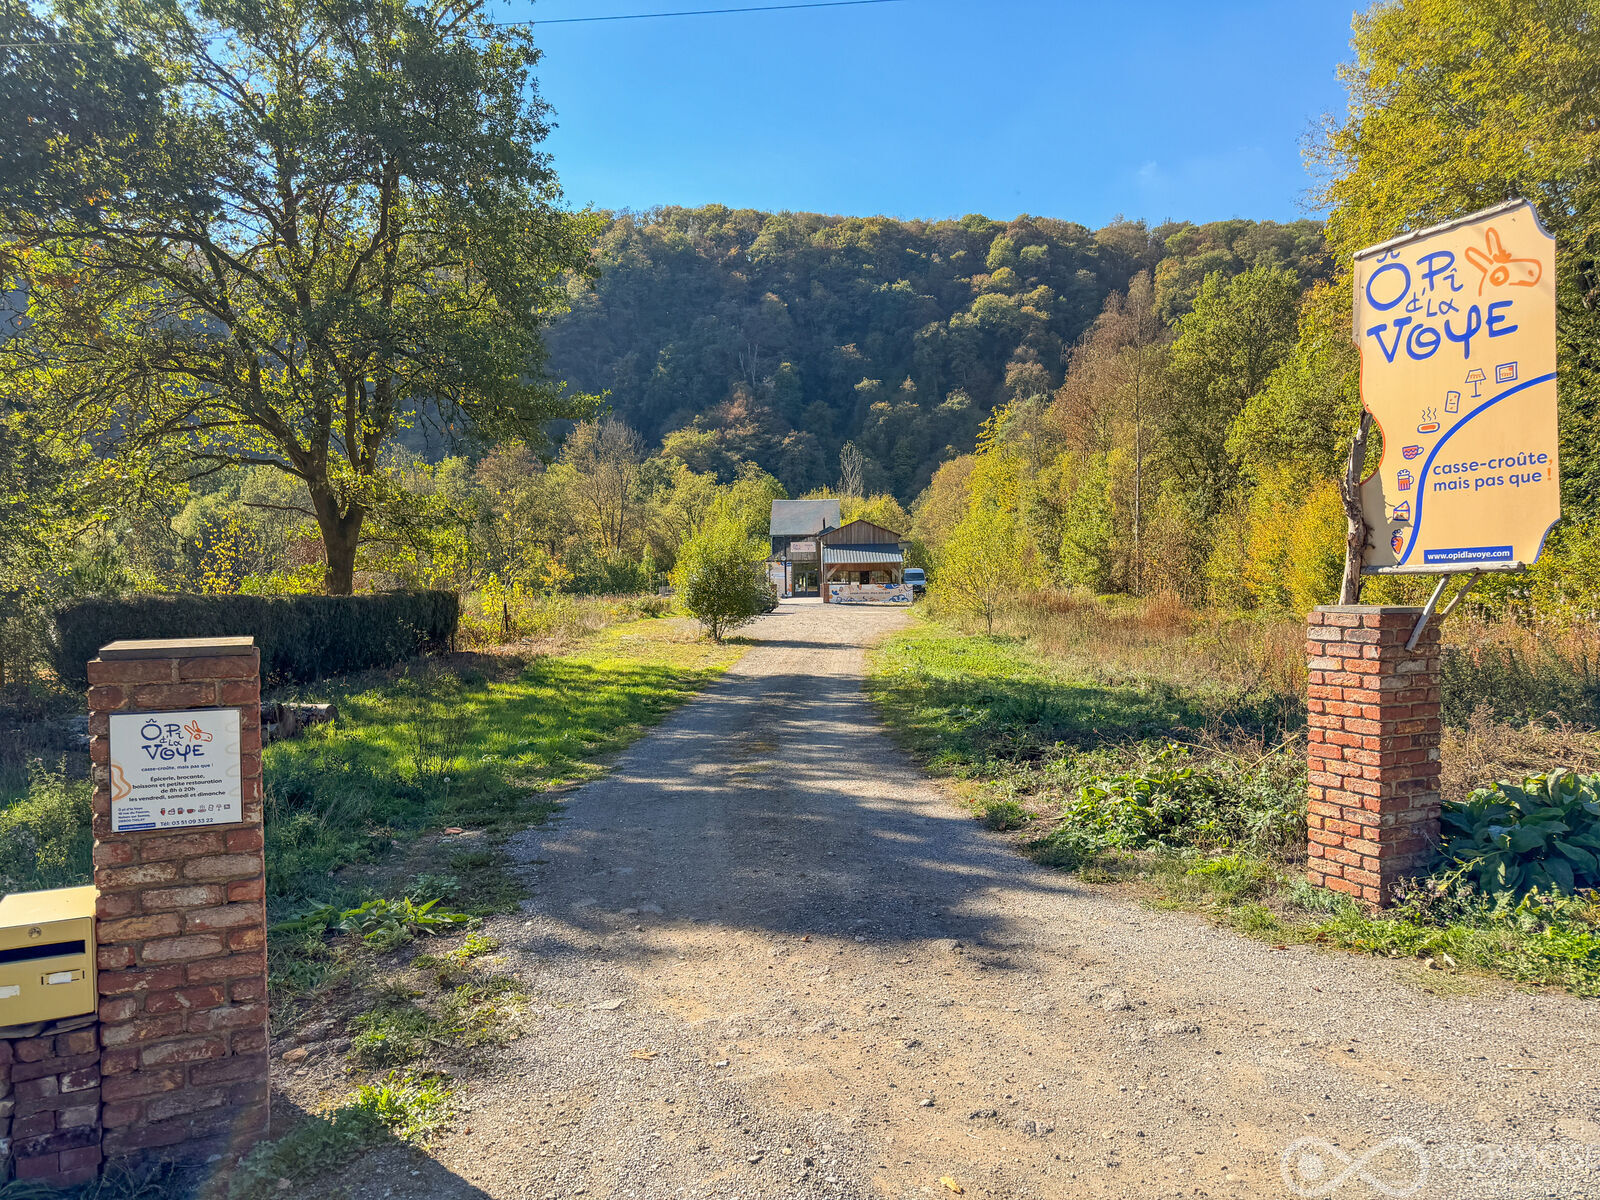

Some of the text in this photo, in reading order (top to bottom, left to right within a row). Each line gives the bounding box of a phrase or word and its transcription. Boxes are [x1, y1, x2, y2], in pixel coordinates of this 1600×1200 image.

[1433, 451, 1553, 475] casse-croûte,
[1433, 476, 1470, 492] mais
[1475, 475, 1504, 491] pas
[1509, 472, 1542, 488] que
[1427, 548, 1510, 561] www.opidlavoye.com
